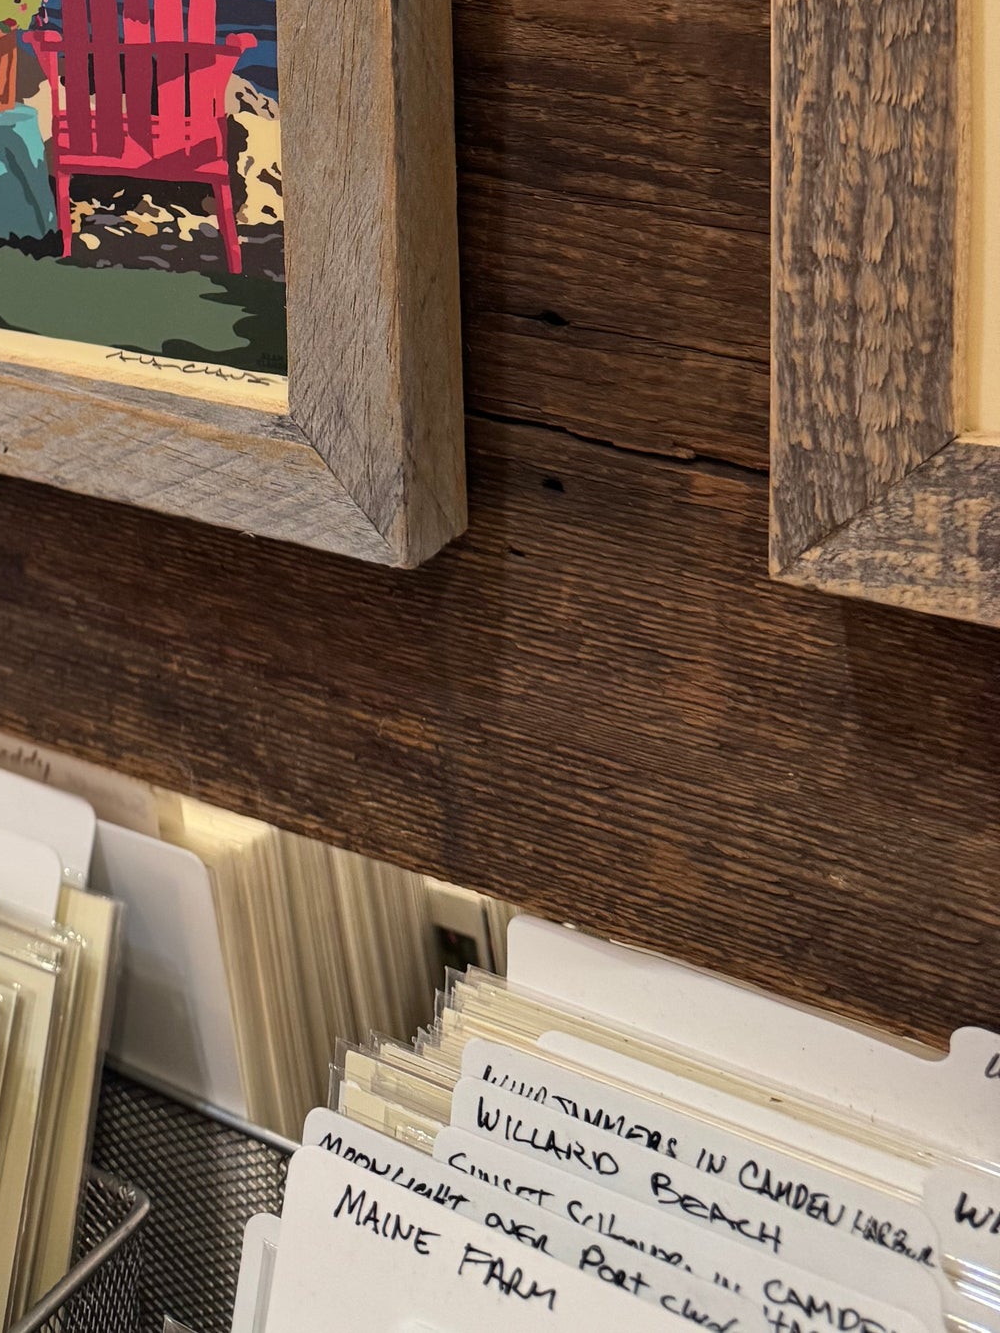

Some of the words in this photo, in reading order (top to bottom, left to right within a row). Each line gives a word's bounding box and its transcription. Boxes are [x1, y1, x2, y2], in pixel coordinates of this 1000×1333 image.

[476, 1095, 620, 1177] WILLARD
[650, 1171, 782, 1254] BEACH
[696, 1147, 727, 1175] IN
[737, 1159, 846, 1227] CAMDEN
[332, 1183, 441, 1256] MAINE
[456, 1241, 558, 1312] FARM
